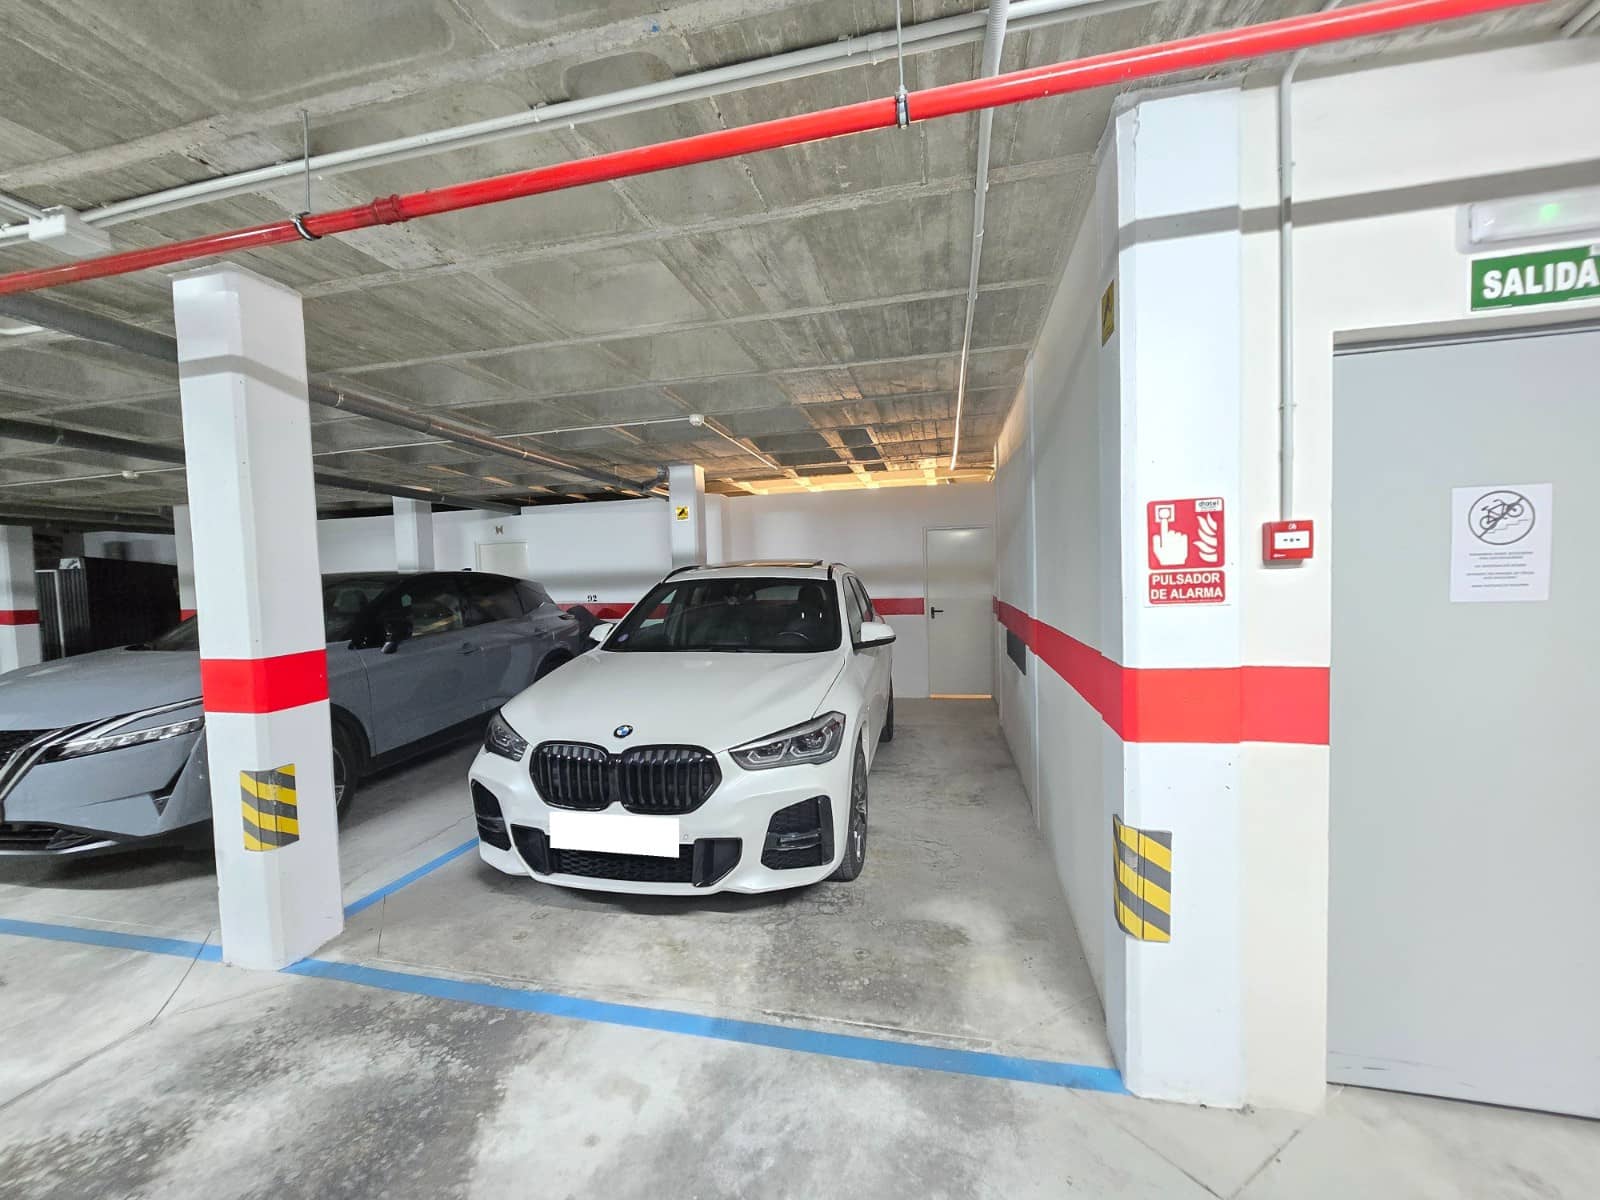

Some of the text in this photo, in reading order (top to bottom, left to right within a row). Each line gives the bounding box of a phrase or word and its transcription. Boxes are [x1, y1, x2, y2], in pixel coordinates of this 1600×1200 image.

[1483, 258, 1600, 299] SALIDA
[1152, 573, 1220, 585] PULSADOR
[1151, 587, 1223, 600] DE ALARMA
